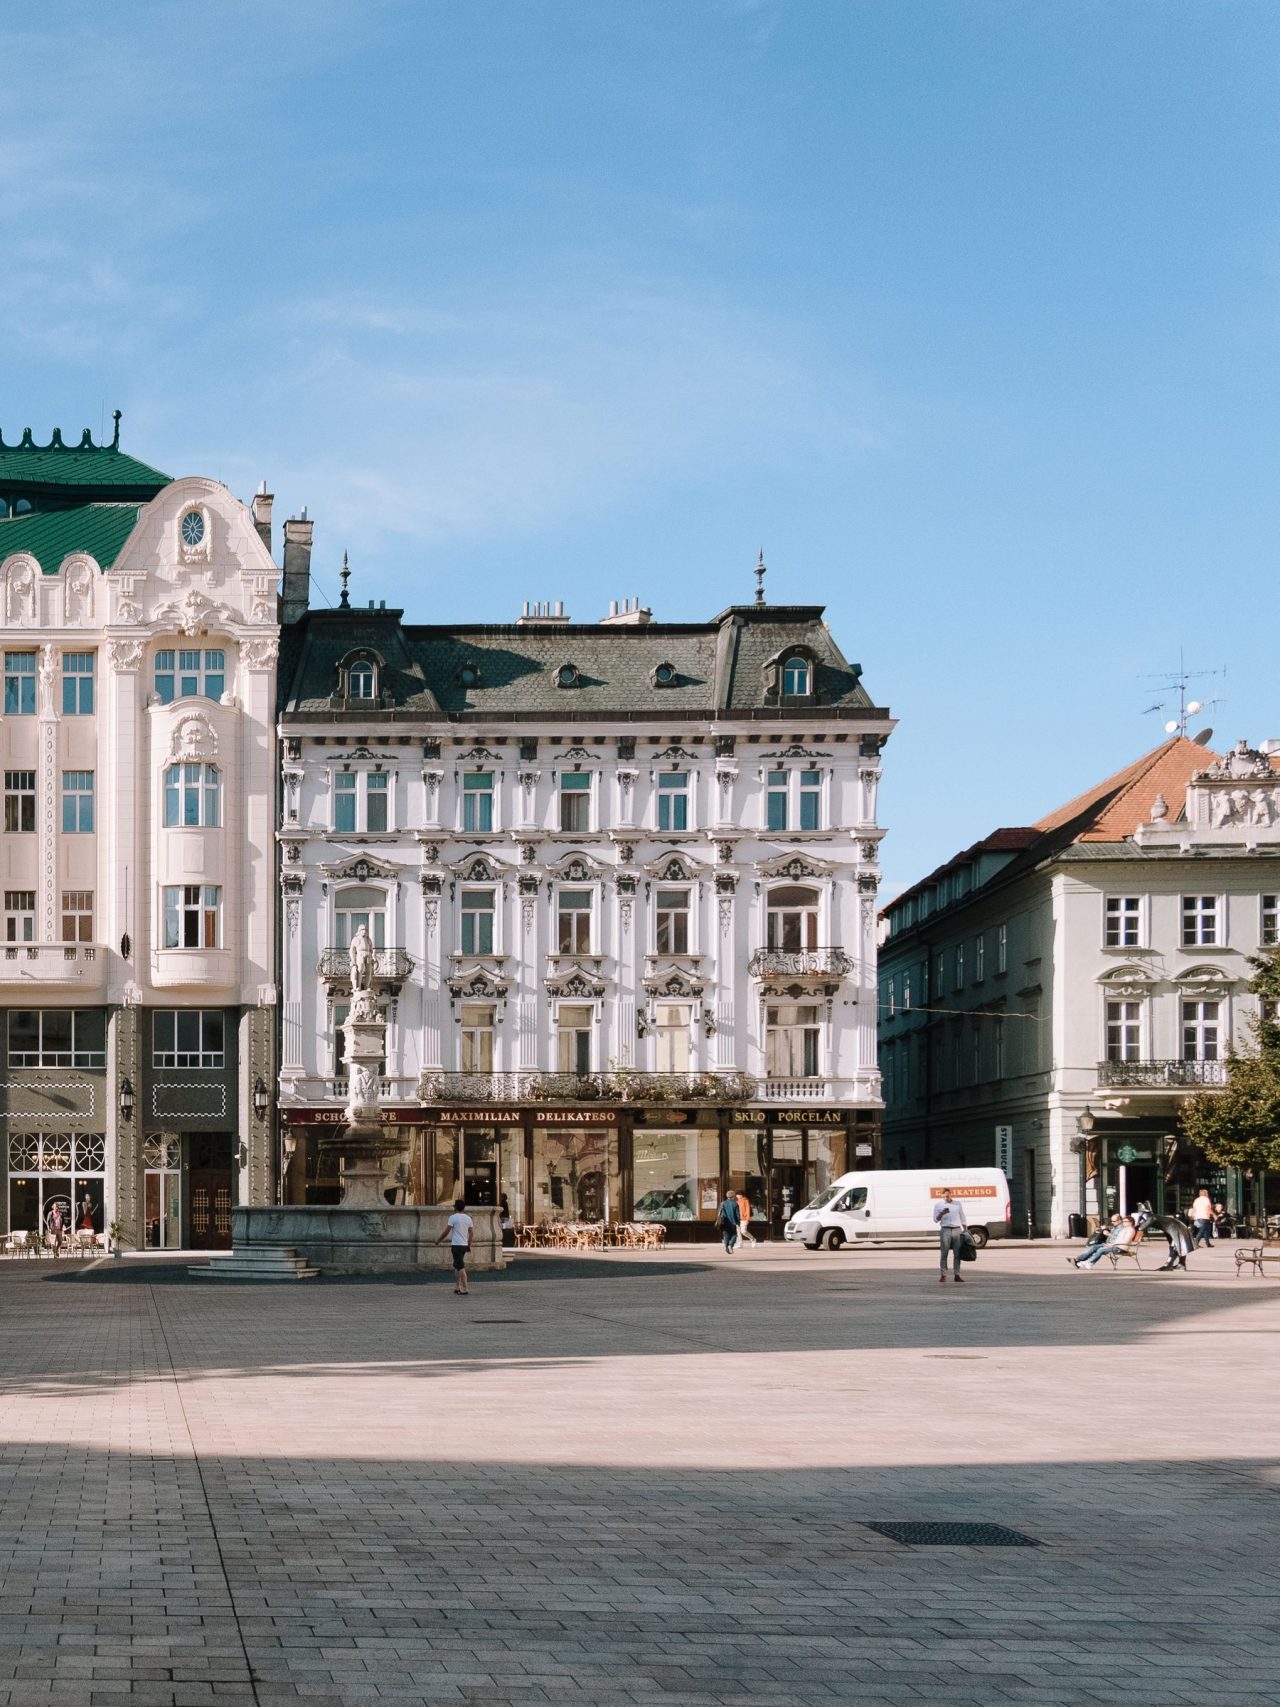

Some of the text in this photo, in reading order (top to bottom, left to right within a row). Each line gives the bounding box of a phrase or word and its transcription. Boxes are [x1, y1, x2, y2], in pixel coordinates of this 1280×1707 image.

[440, 1112, 616, 1121] MAXIMILIAN DELIKATESO
[735, 1111, 841, 1122] SKLO PORCELÁN
[935, 1188, 992, 1197] DIKATESO
